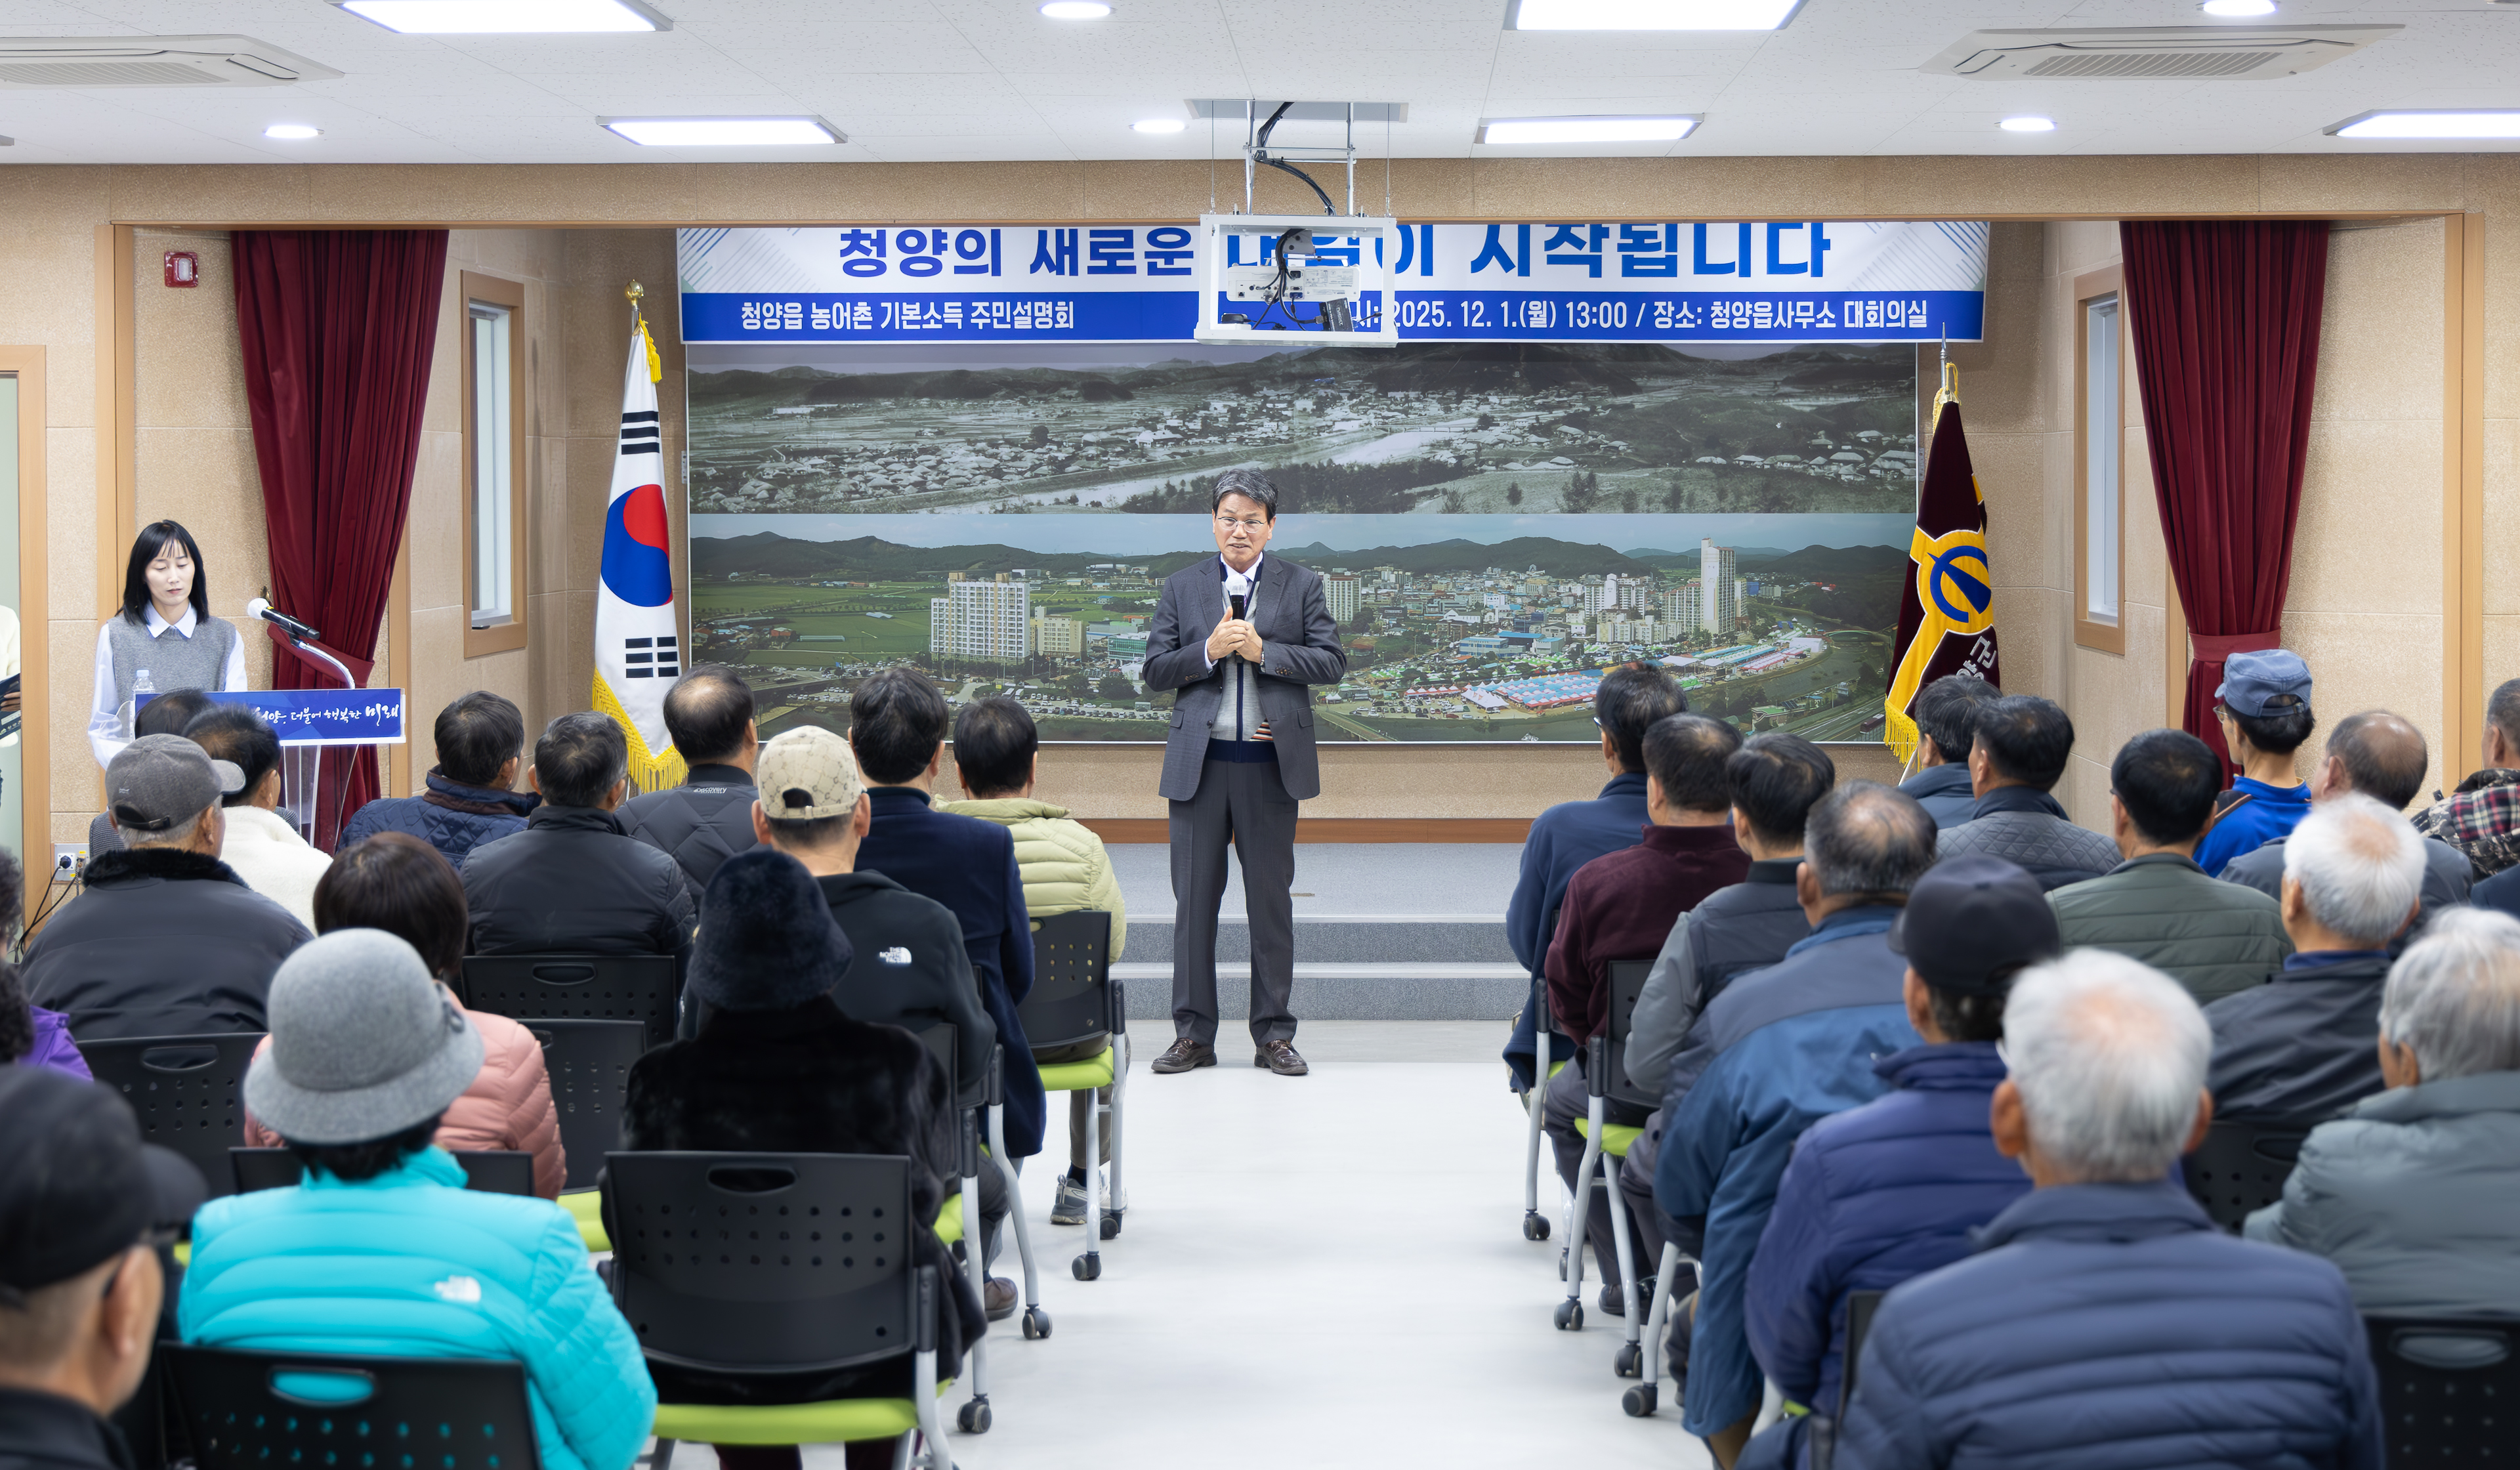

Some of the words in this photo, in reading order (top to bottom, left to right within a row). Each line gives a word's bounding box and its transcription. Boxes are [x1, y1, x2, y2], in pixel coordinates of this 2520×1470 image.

[840, 229, 1001, 277] 청양의
[1030, 227, 1194, 277] 새로운
[1471, 224, 1830, 278] 시작됩니다
[741, 302, 803, 330] 청양읍
[810, 301, 873, 330] 농어촌
[880, 301, 963, 329] 기본소득
[970, 301, 1074, 329] 주민설명회
[1394, 301, 1452, 327] 2025.
[1460, 301, 1491, 327] 12.
[1566, 301, 1627, 328] 13:00
[1635, 303, 1646, 327] /
[1653, 301, 1702, 329] 장소:
[1710, 301, 1836, 329] 청양읍사무소
[1844, 300, 1927, 328] 대회의실
[290, 707, 322, 724] 더불어
[323, 707, 362, 724] 행복한
[365, 703, 400, 726] 미래
